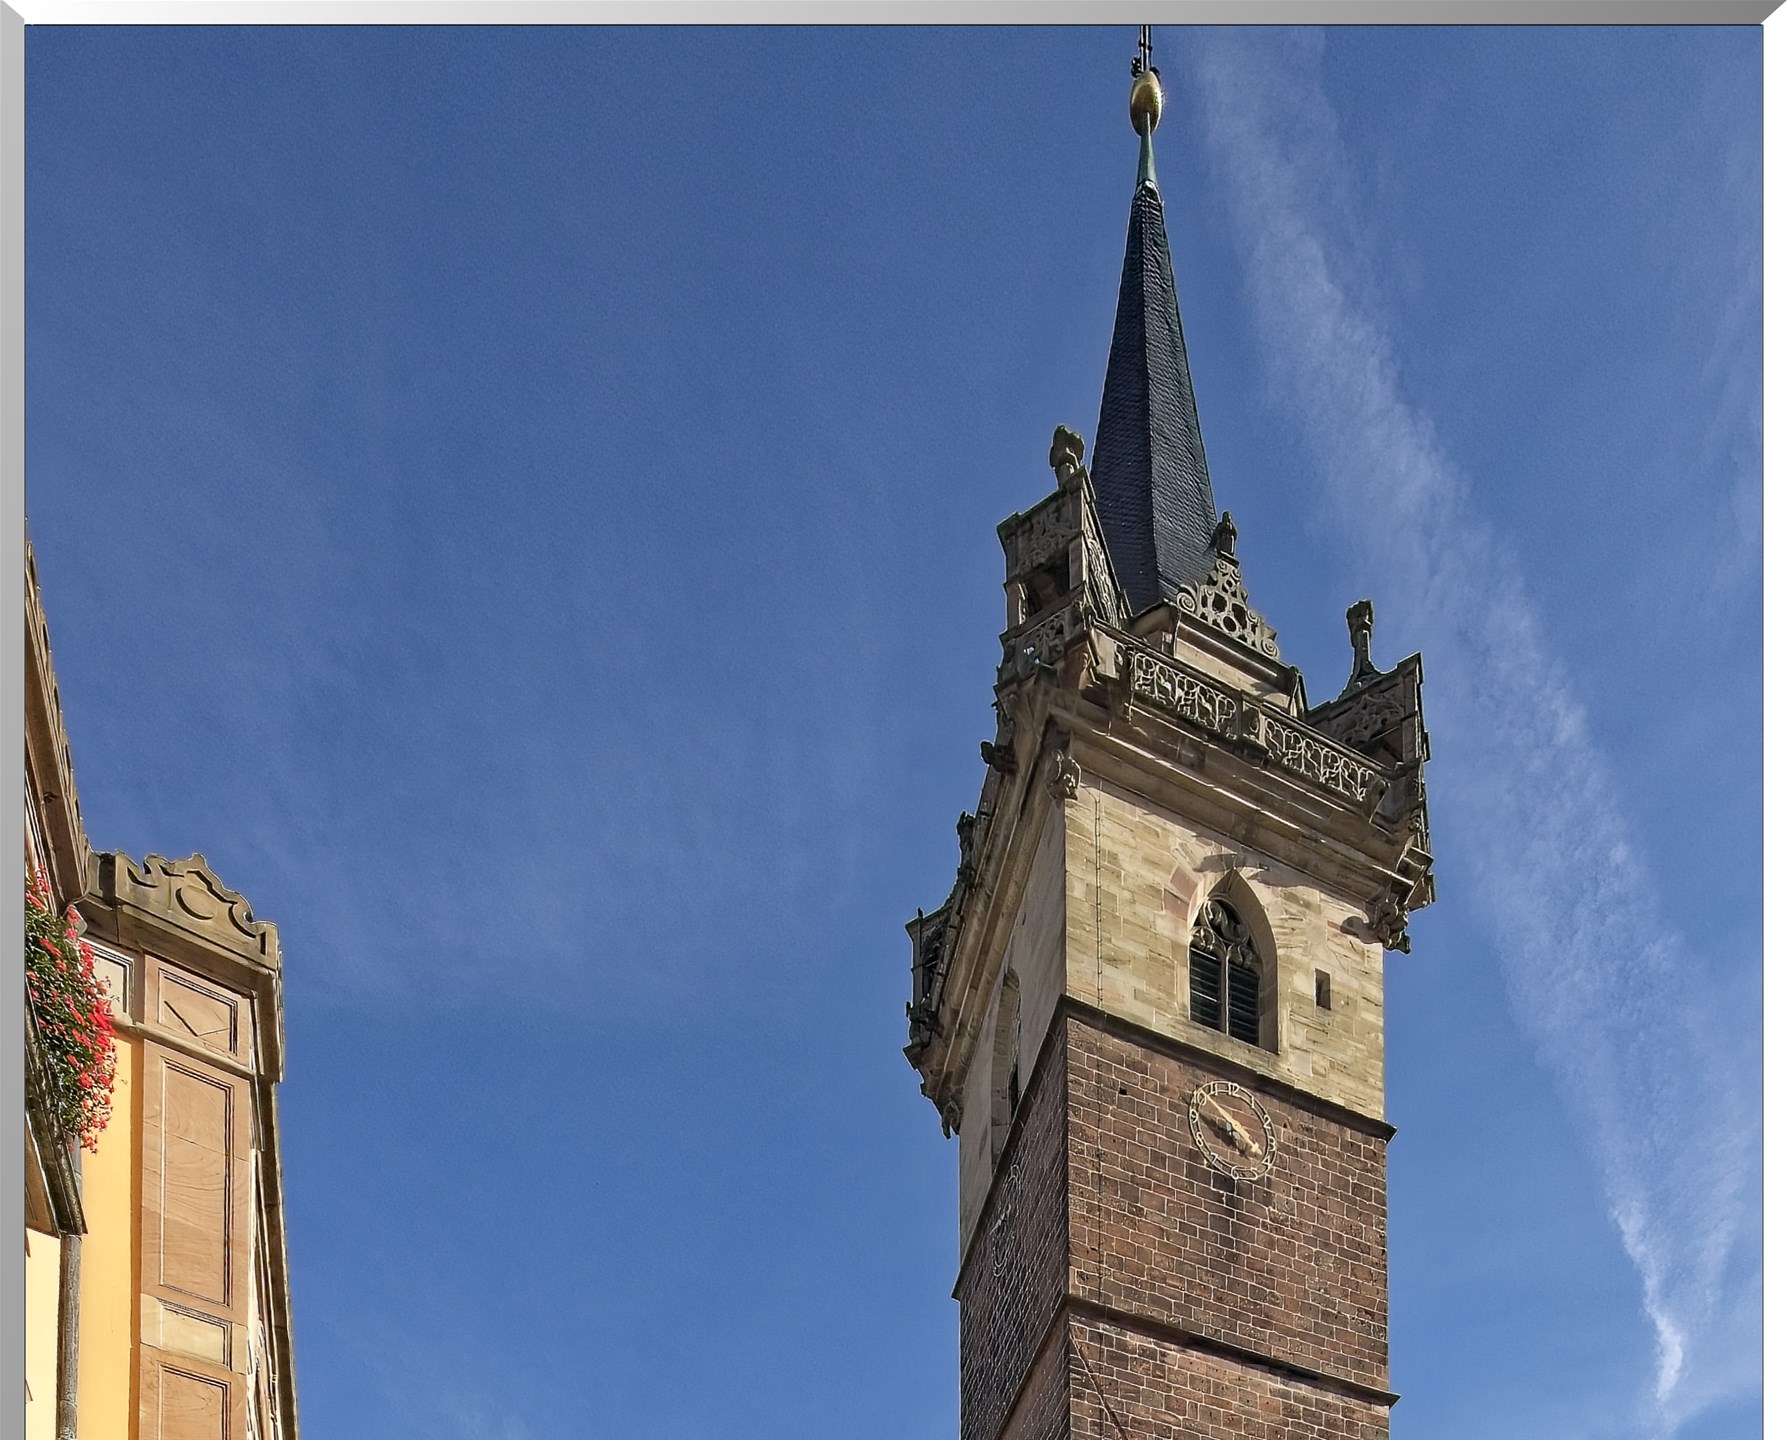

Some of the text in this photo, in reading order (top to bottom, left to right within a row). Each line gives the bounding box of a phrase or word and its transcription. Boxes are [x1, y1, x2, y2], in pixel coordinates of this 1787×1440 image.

[1210, 1082, 1219, 1096] 11
[1228, 1082, 1241, 1098] 12
[1193, 1089, 1207, 1106] 10
[1189, 1108, 1199, 1124] 9
[1263, 1114, 1272, 1130] 2
[1195, 1131, 1204, 1147] 8
[1267, 1135, 1277, 1152] 3
[1210, 1151, 1219, 1165] 7
[1261, 1154, 1273, 1170] 4
[1230, 1165, 1240, 1180] 6
[1250, 1166, 1258, 1181] 5
